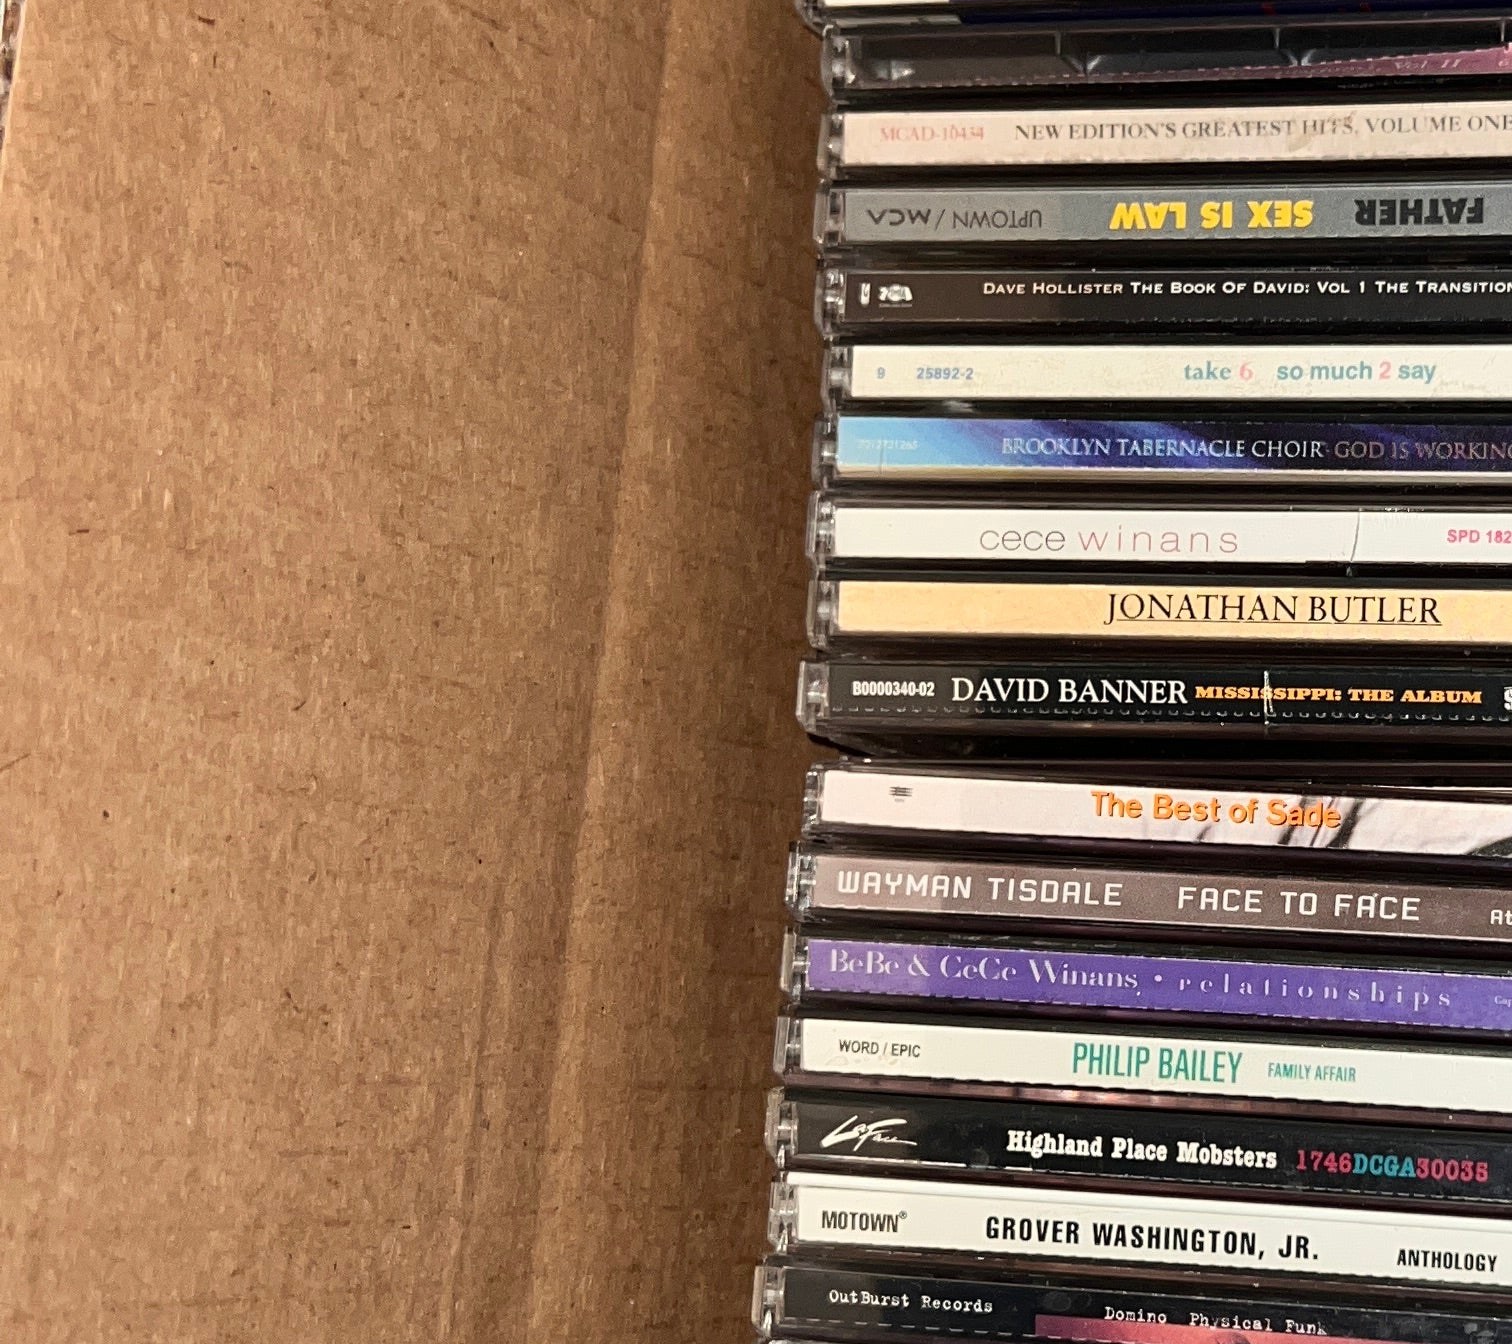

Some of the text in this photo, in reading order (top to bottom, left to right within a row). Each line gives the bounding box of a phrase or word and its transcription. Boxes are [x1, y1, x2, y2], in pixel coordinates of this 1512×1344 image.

[1109, 196, 1485, 230] LAW IS SEX FATHER
[916, 367, 974, 380] 25892-2
[1184, 361, 1436, 384] take 6 so much 2 say
[979, 524, 1239, 553] cece winans
[1447, 528, 1481, 544] SPD
[1104, 593, 1441, 626] JONATHAN BUTLER
[852, 680, 935, 698] B0000340-02
[951, 677, 1188, 705] DAVID BANNER
[1091, 790, 1342, 828] The Best of Sade
[838, 870, 1421, 921] WAYMAN TISDALE FACE TO FACE
[1072, 1041, 1356, 1084] PHILIP BAILEY FAMILY AFFAIR
[1007, 1129, 1277, 1169] Highland Place Mobsters
[986, 1215, 1497, 1272] GROVER WASHINGTON, JR. ANTHOLOGY
